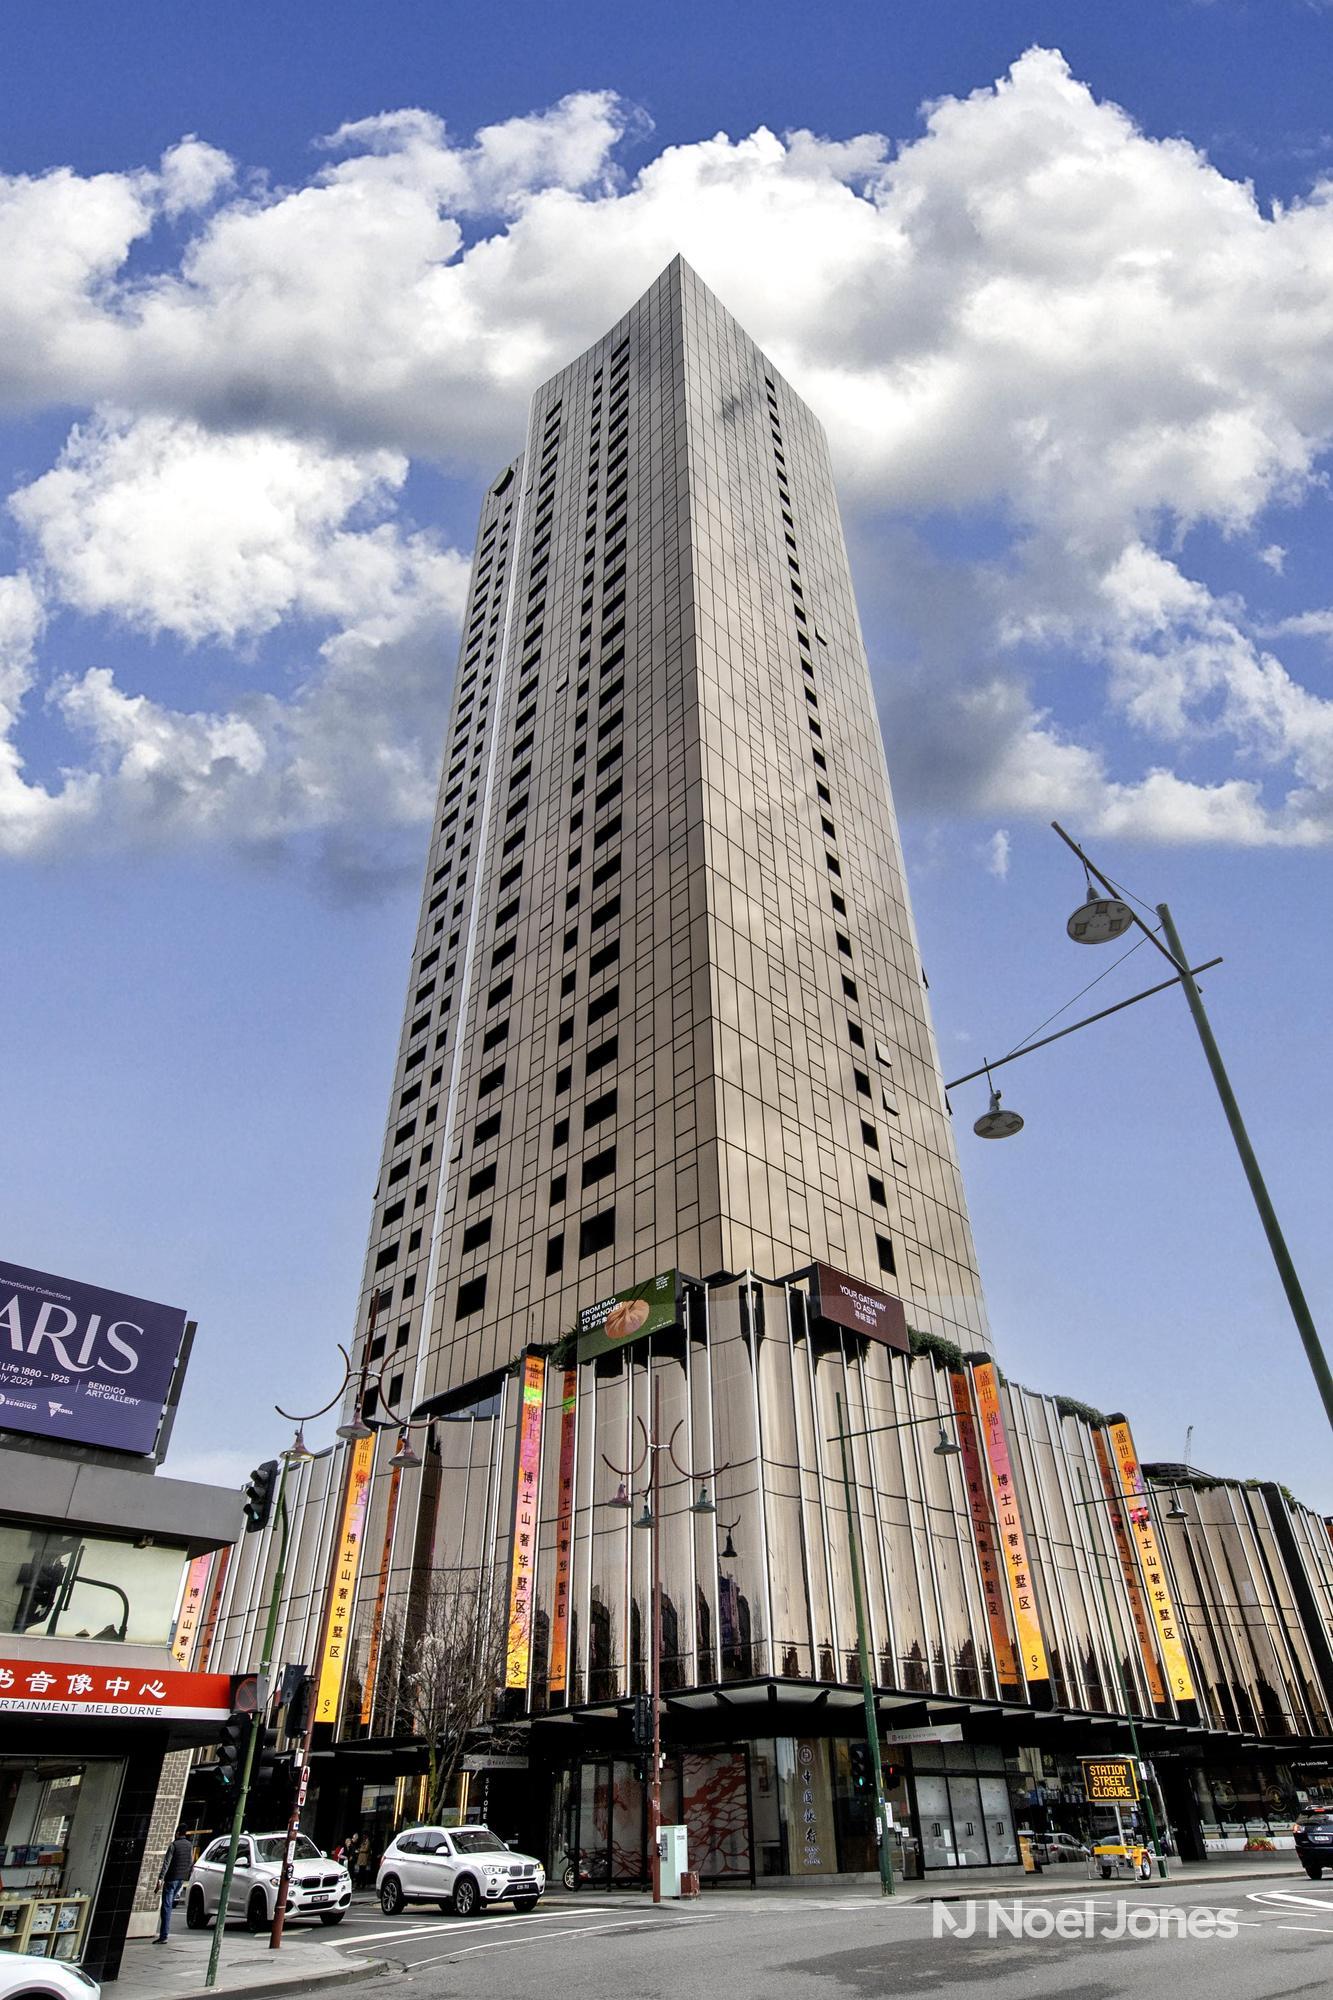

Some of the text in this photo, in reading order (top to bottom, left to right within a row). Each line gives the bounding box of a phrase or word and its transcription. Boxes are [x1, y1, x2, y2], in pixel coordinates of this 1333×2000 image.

[36, 1287, 71, 1301] Collections
[839, 1284, 887, 1312] YOUR GATEWAY
[581, 1298, 616, 1318] FROM BAO
[591, 1302, 623, 1320] BANQUET
[852, 1300, 877, 1318] TO ASIA
[0, 1294, 144, 1374] ARIS
[1, 1362, 19, 1373] Life
[21, 1367, 41, 1377] 1880
[51, 1373, 70, 1384] 1925
[10, 1375, 33, 1386] 2024
[88, 1381, 126, 1395] BENDIGO
[5, 1400, 37, 1410] BENDIGO
[85, 1389, 141, 1406] ART GALLERY
[0, 1668, 167, 1699] 书音像中心
[0, 1700, 163, 1716] RTAINMENT MELBOURNE
[1090, 1765, 1127, 1776] STATION
[1093, 1776, 1126, 1786] STREET
[1092, 1787, 1132, 1798] CLOSURE
